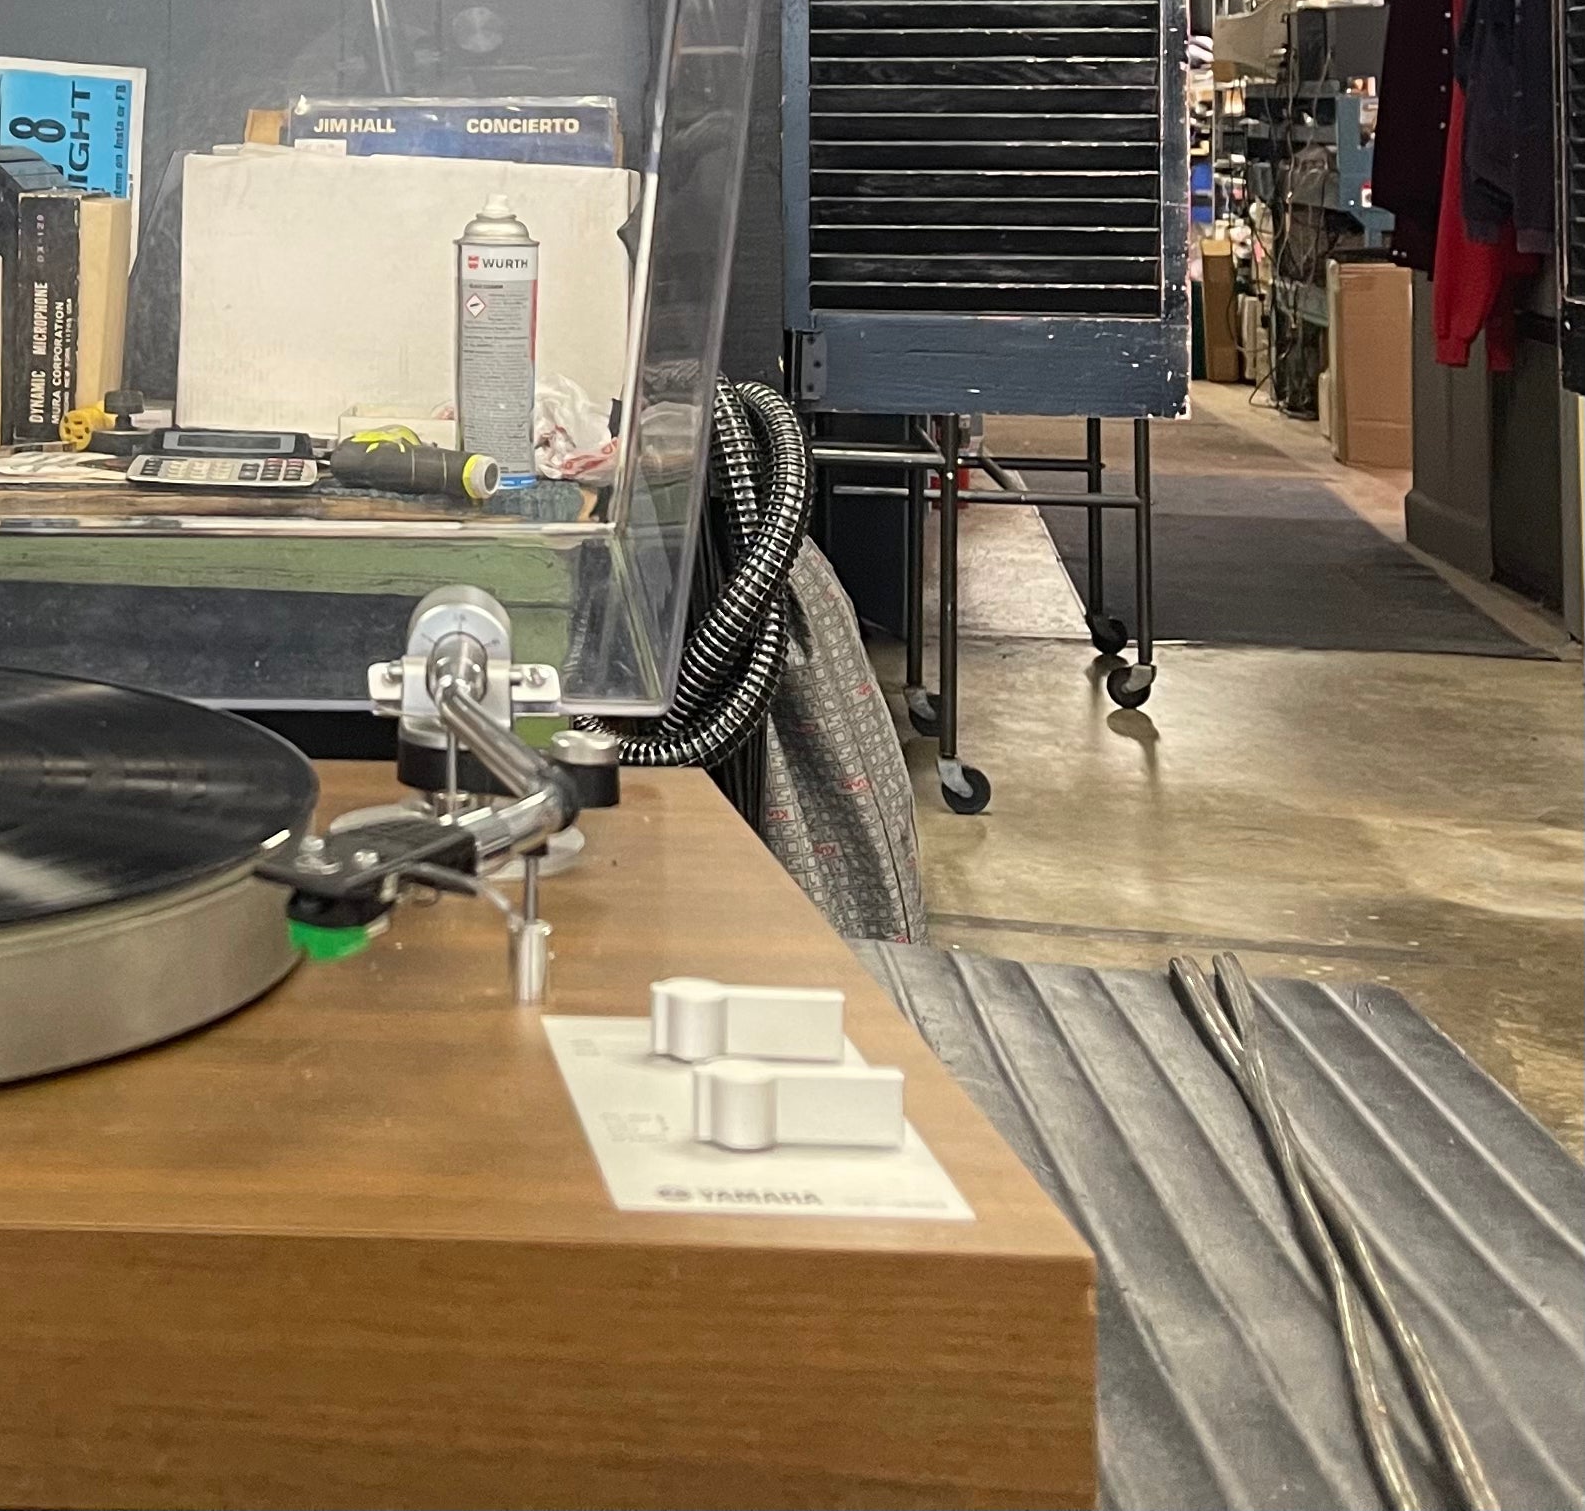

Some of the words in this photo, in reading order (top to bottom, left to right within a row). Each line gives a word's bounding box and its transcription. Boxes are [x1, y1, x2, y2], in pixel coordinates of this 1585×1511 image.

[9, 116, 67, 143] 8
[67, 80, 91, 192] IGHT
[314, 118, 348, 134] JIM
[350, 117, 397, 134] HALL
[466, 117, 581, 135] CONCIERTO
[32, 281, 49, 357] MICROPHONE
[52, 301, 65, 387] CORPORATION
[28, 370, 46, 425] DYNAMIC
[51, 394, 62, 426] MURA
[696, 1187, 824, 1206] YAMAHA
